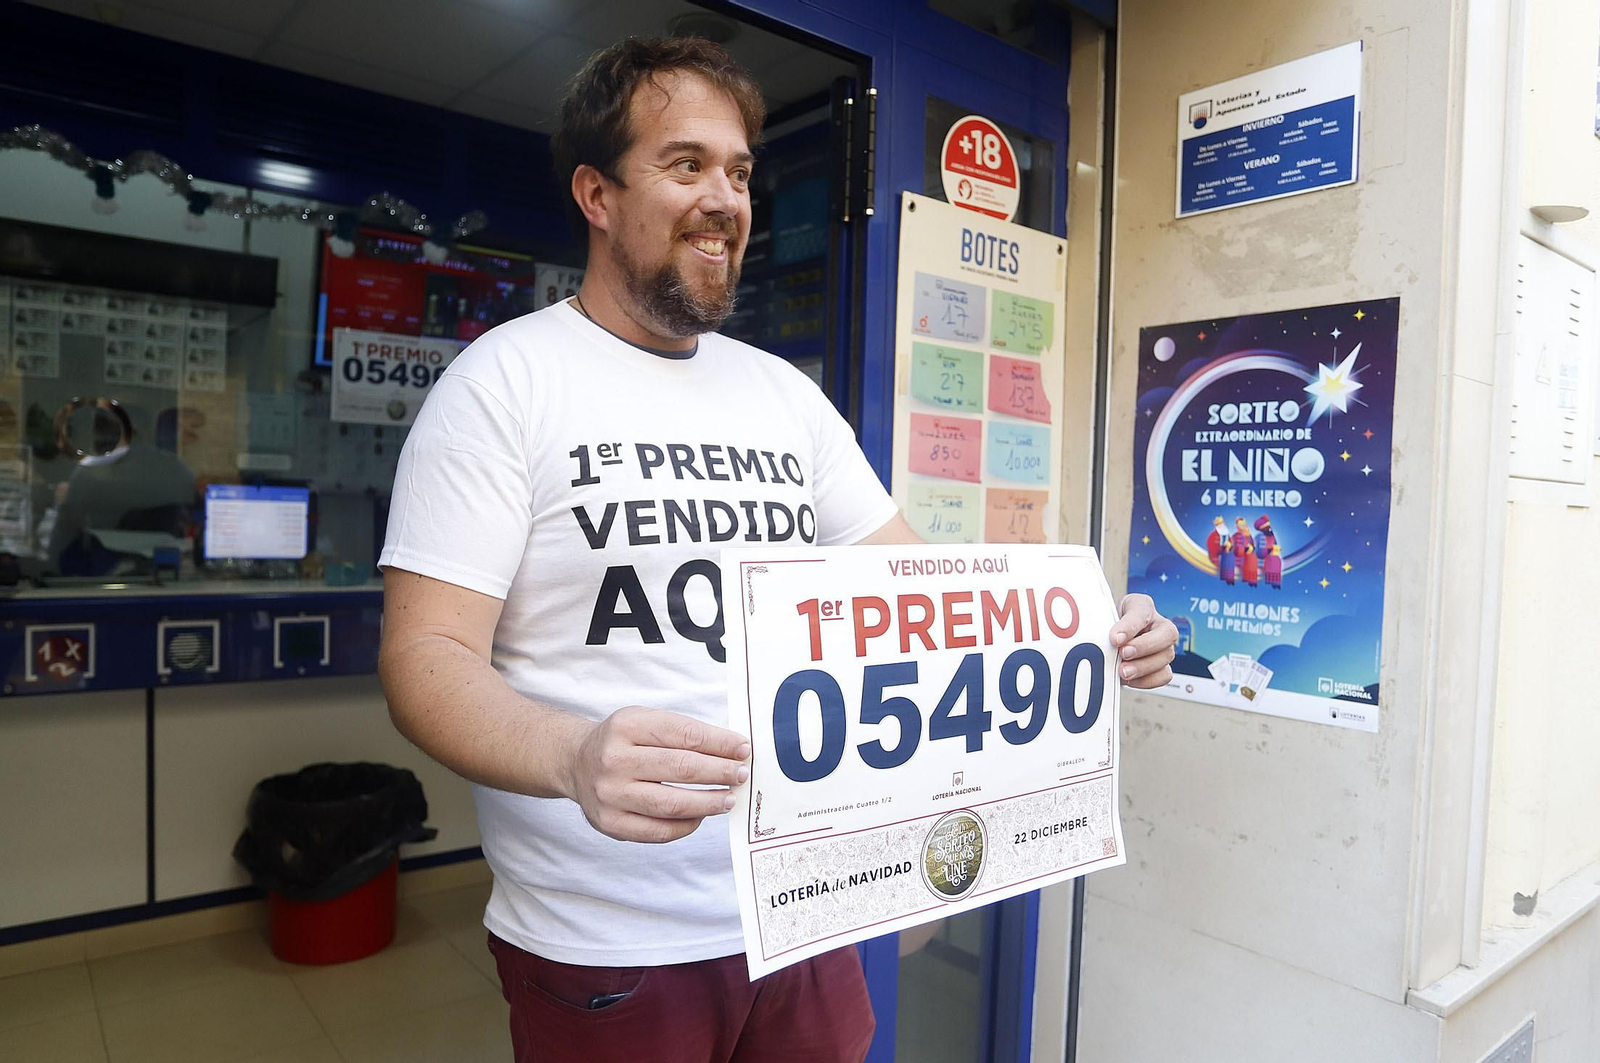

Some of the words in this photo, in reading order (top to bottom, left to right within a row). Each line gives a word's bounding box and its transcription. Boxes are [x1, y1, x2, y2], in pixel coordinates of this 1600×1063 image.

[1215, 101, 1254, 116] Apuestas
[1257, 97, 1270, 105] del
[1276, 87, 1307, 99] Estado
[1242, 115, 1285, 132] INVIERNO
[958, 129, 1002, 170] +18
[1243, 154, 1280, 170] VERANO
[961, 228, 1019, 275] BOTES
[367, 342, 442, 364] PREMIO
[1207, 400, 1300, 426] SORTEO
[1195, 429, 1293, 443] EXTRAORDINARIO
[1296, 428, 1312, 441] DE
[634, 442, 804, 487] PREMIO
[1181, 449, 1218, 482] EL
[1228, 447, 1325, 483] NIÑO
[1200, 488, 1211, 505] 6
[1216, 489, 1237, 507] DE
[1241, 489, 1302, 508] ENERO
[571, 499, 816, 550] VENDIDO
[888, 558, 966, 577] VENDIDO
[972, 554, 1009, 575] AQUÍ
[585, 559, 726, 663] AQ
[796, 598, 844, 661] 1er
[852, 586, 1080, 657] PREMIO
[1190, 597, 1220, 615] 700
[1222, 601, 1300, 624] MILLONES
[1207, 616, 1223, 630] EN
[1225, 618, 1281, 637] PREMIOS
[1334, 688, 1372, 700] NACIONAL
[772, 642, 1105, 783] 05490
[955, 786, 982, 796] NACIONAL
[797, 804, 854, 818] Administración
[857, 799, 879, 809] Cuatro
[1014, 832, 1027, 844] 22
[1030, 816, 1088, 840] DICIEMBRE
[934, 830, 976, 862] SORTEO
[944, 852, 959, 864] QUE
[960, 845, 975, 860] NOS
[771, 879, 830, 908] LOTERÍA
[832, 878, 847, 892] de
[848, 861, 912, 887] NAVIDAD
[941, 860, 968, 887] UNE
